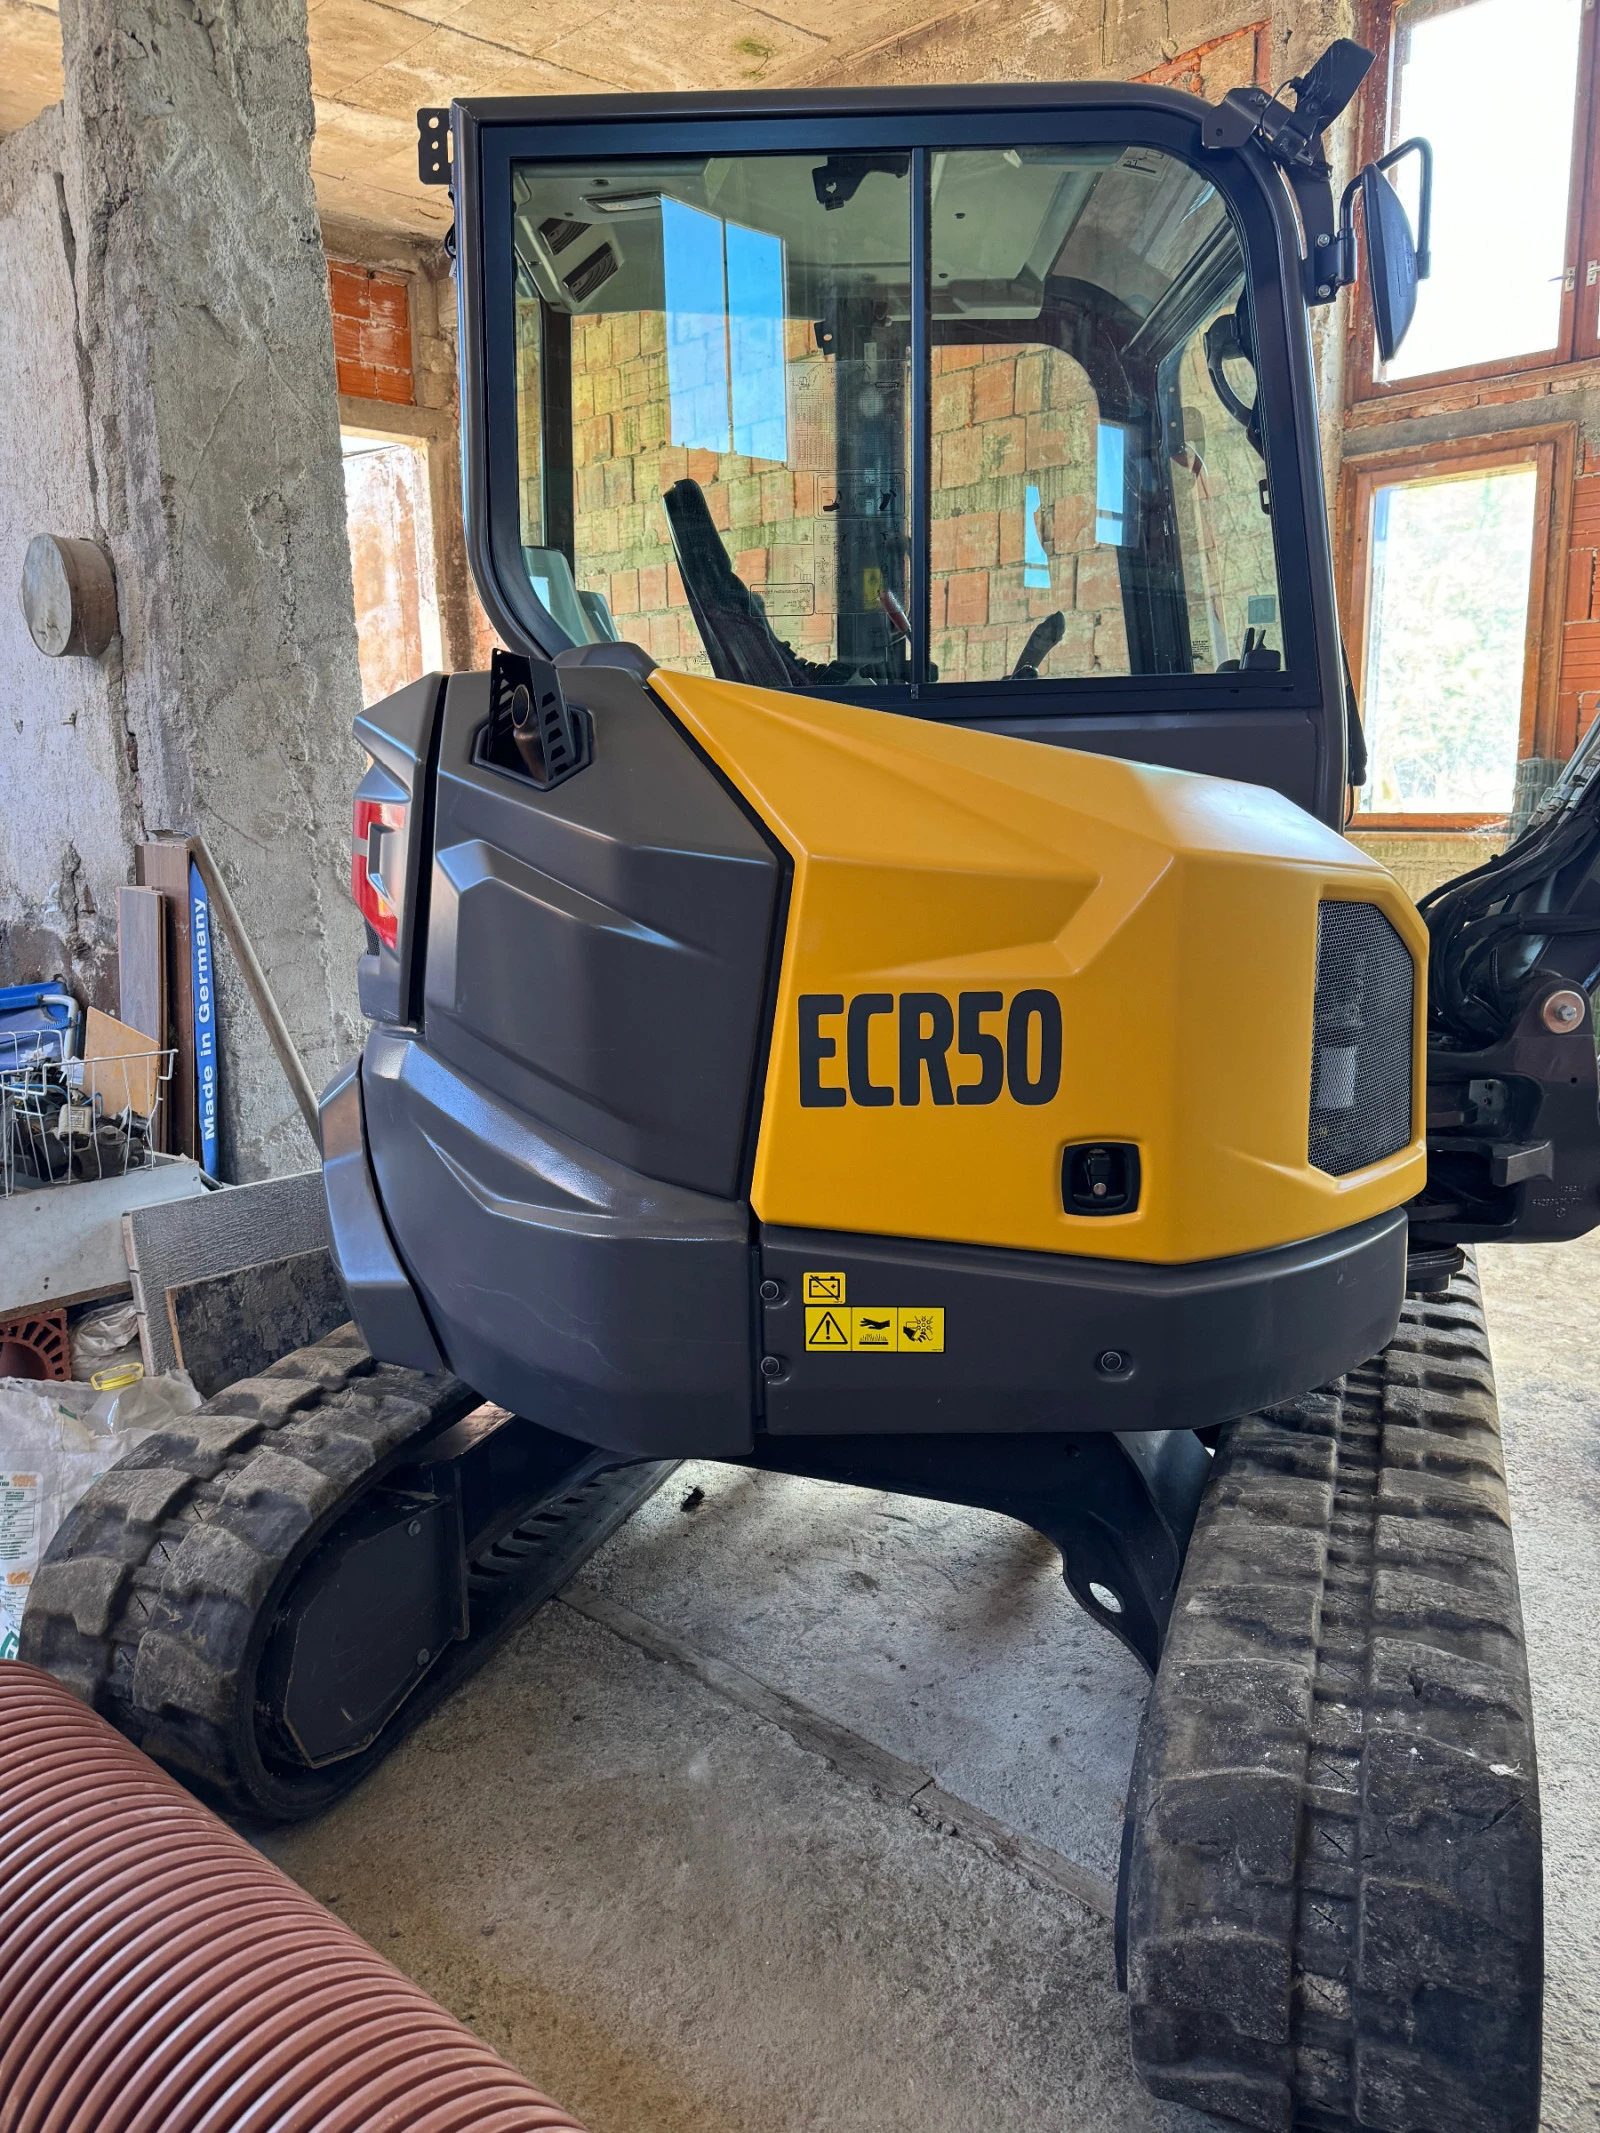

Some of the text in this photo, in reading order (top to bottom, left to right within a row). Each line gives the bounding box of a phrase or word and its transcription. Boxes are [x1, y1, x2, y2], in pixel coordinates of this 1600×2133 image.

[194, 896, 215, 1141] Made in Germany
[798, 989, 1063, 1108] ECR50
